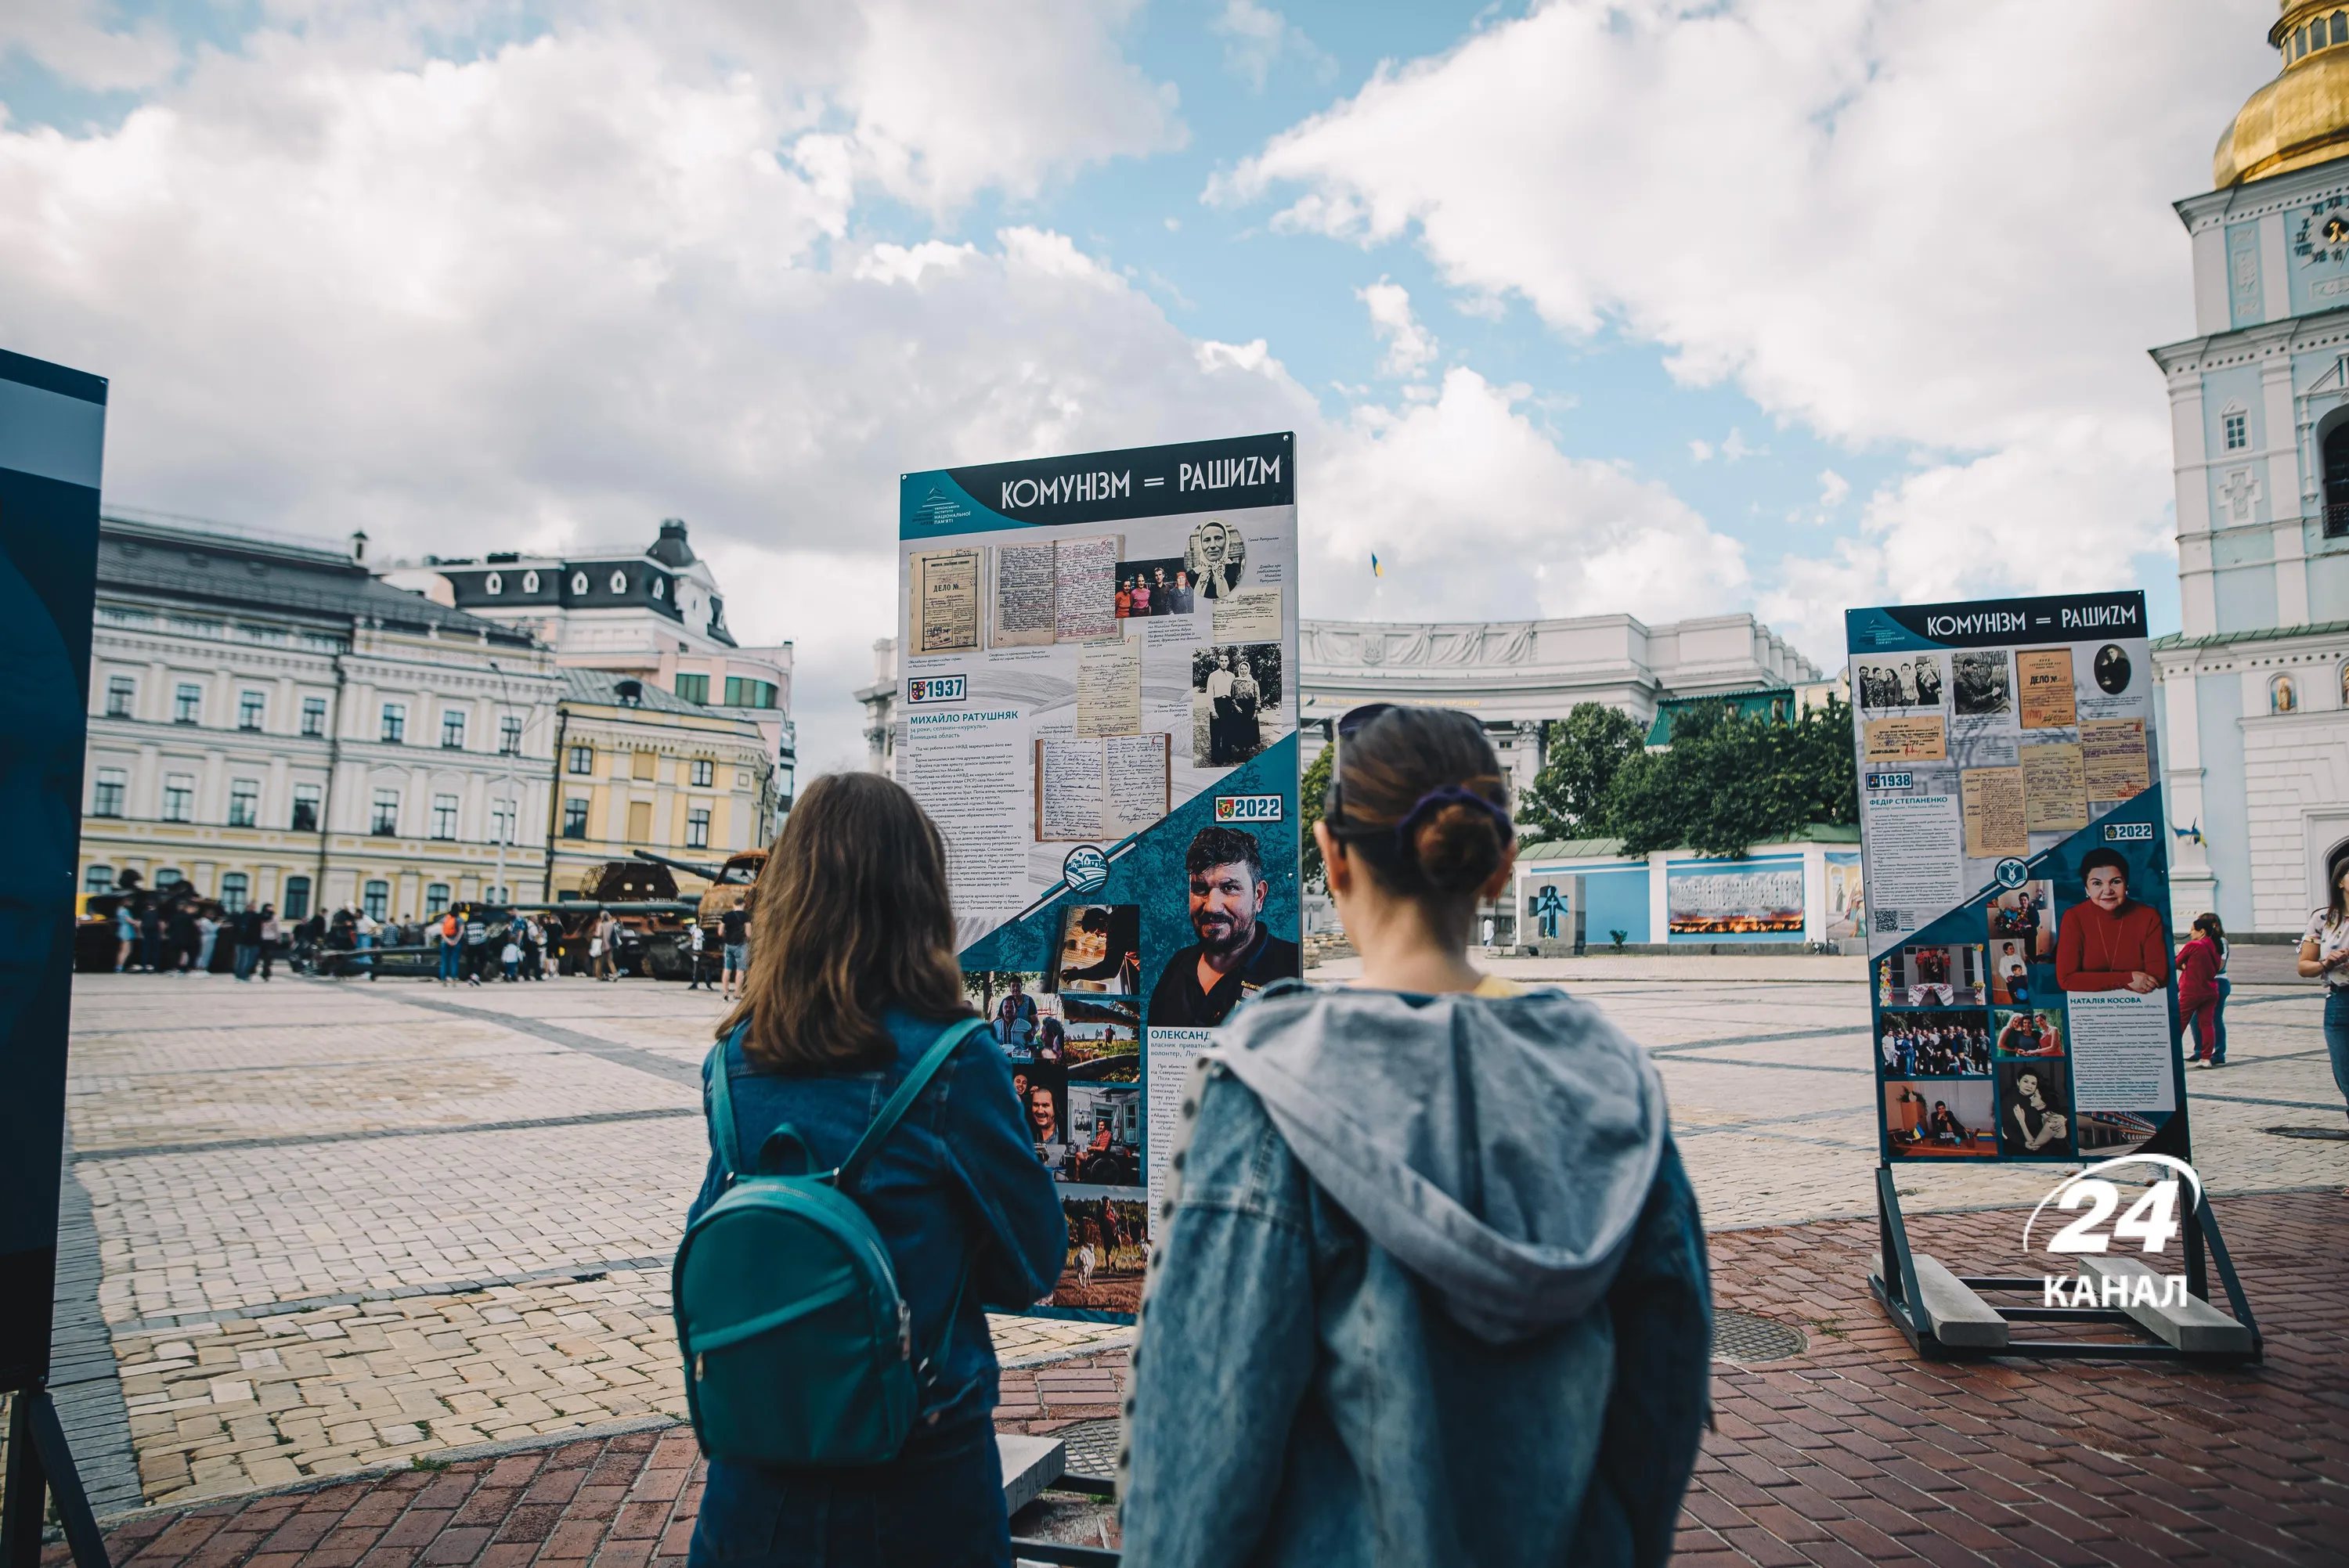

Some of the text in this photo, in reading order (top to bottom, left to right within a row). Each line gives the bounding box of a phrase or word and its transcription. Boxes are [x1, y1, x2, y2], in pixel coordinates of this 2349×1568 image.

[1001, 470, 1130, 509] КОМУНІЗМ
[933, 584, 951, 593] ДЕЛО
[1927, 611, 2026, 637] КОМУНІЗМ
[2030, 675, 2049, 686] ДЕЛО
[926, 679, 962, 697] 1937
[910, 711, 1018, 725] МИХАЙЛО РАТУШНЯК
[910, 733, 937, 741] Вінницька
[1880, 774, 1911, 787] 1938
[1895, 796, 1948, 805] СТЕПАНЕНКО
[1235, 799, 1279, 817] 2022
[2119, 824, 2152, 839] 2022
